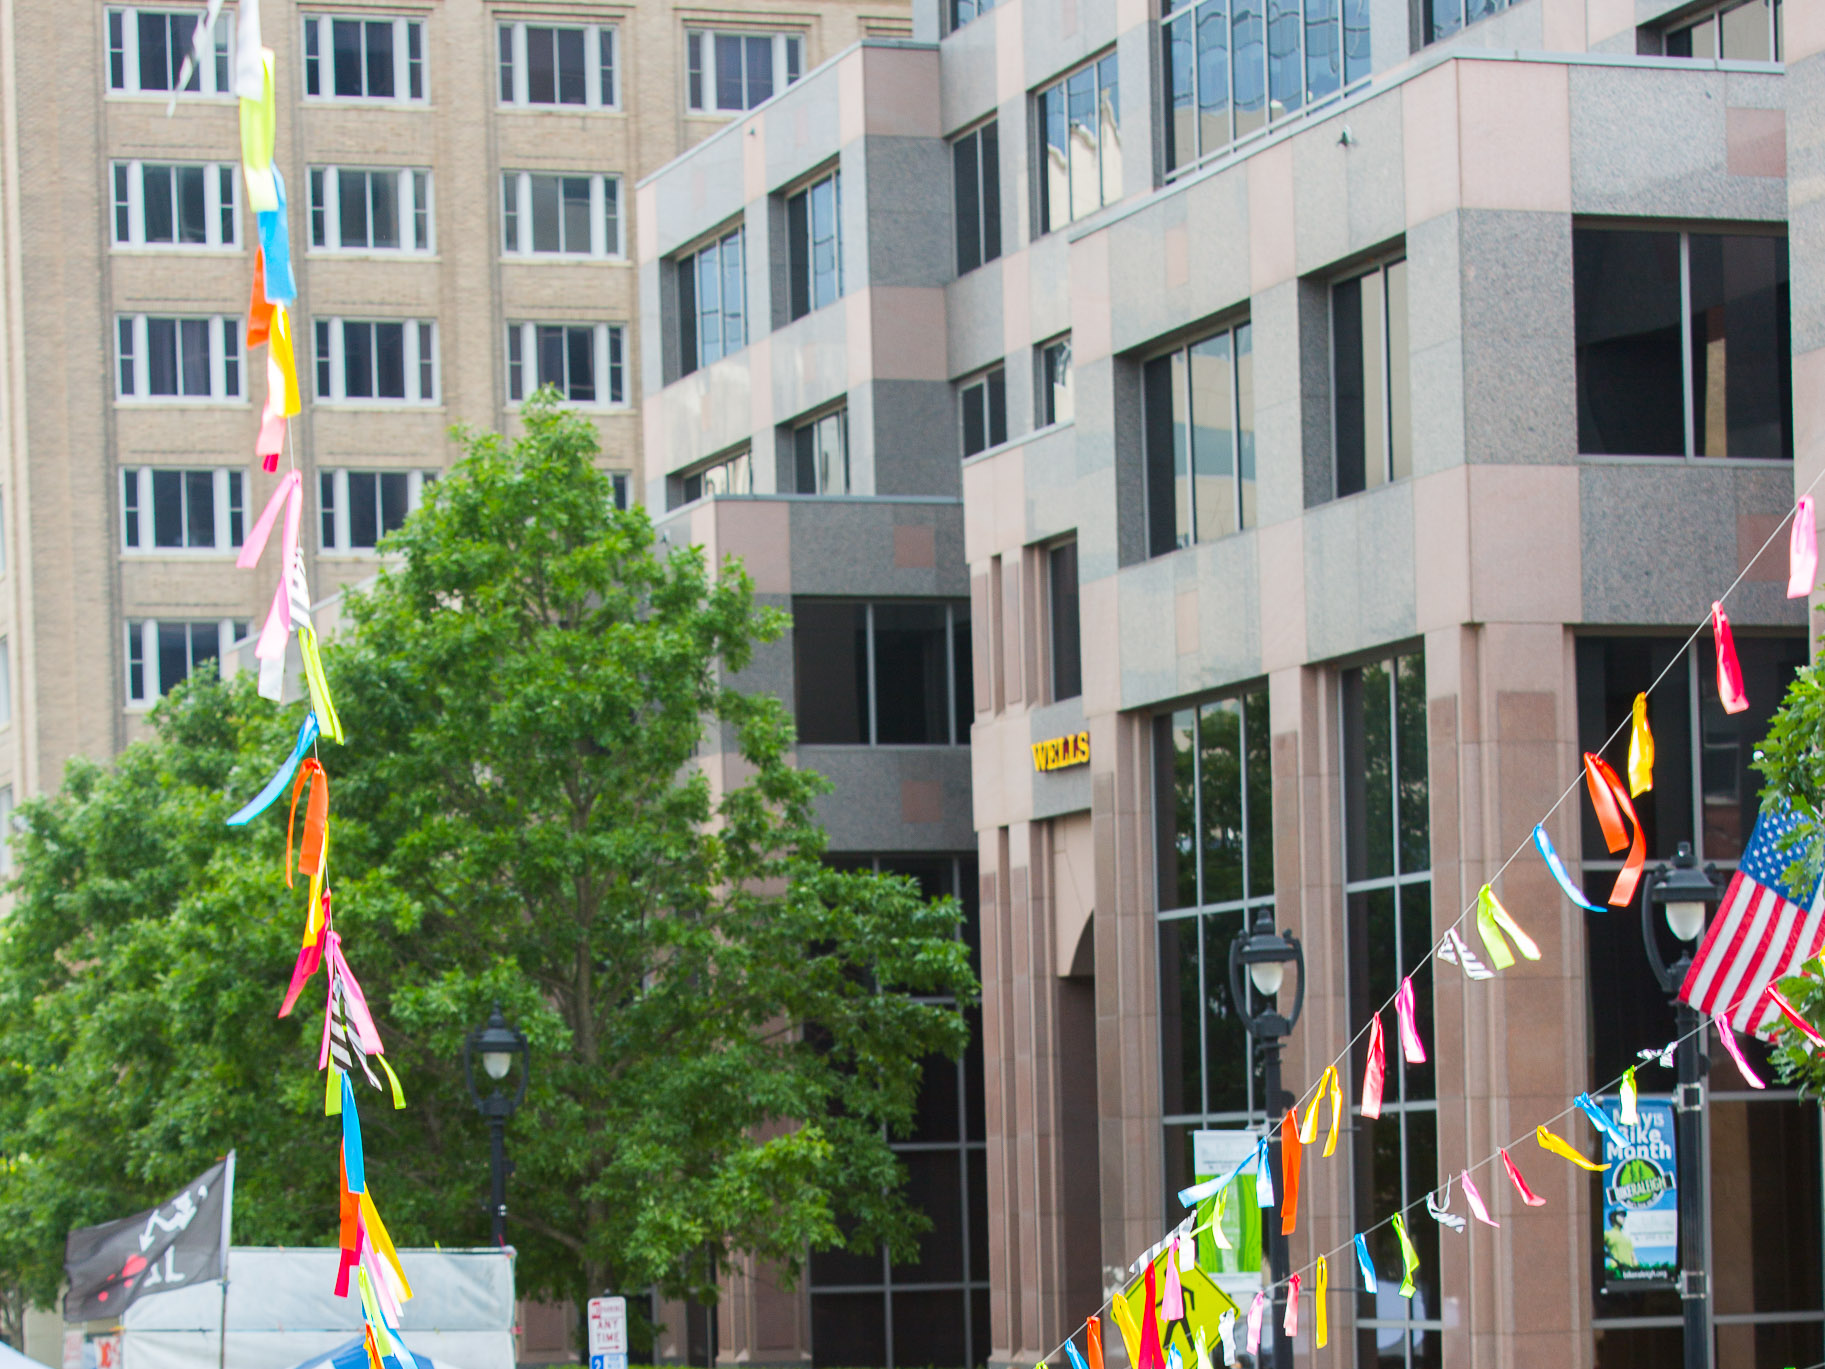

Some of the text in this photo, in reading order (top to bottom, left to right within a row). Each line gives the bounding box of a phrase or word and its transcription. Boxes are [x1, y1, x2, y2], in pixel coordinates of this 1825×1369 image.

[1030, 731, 1089, 772] WELLS
[1606, 1141, 1672, 1160] Month
[597, 1319, 619, 1330] ANY
[596, 1331, 621, 1343] TIME
